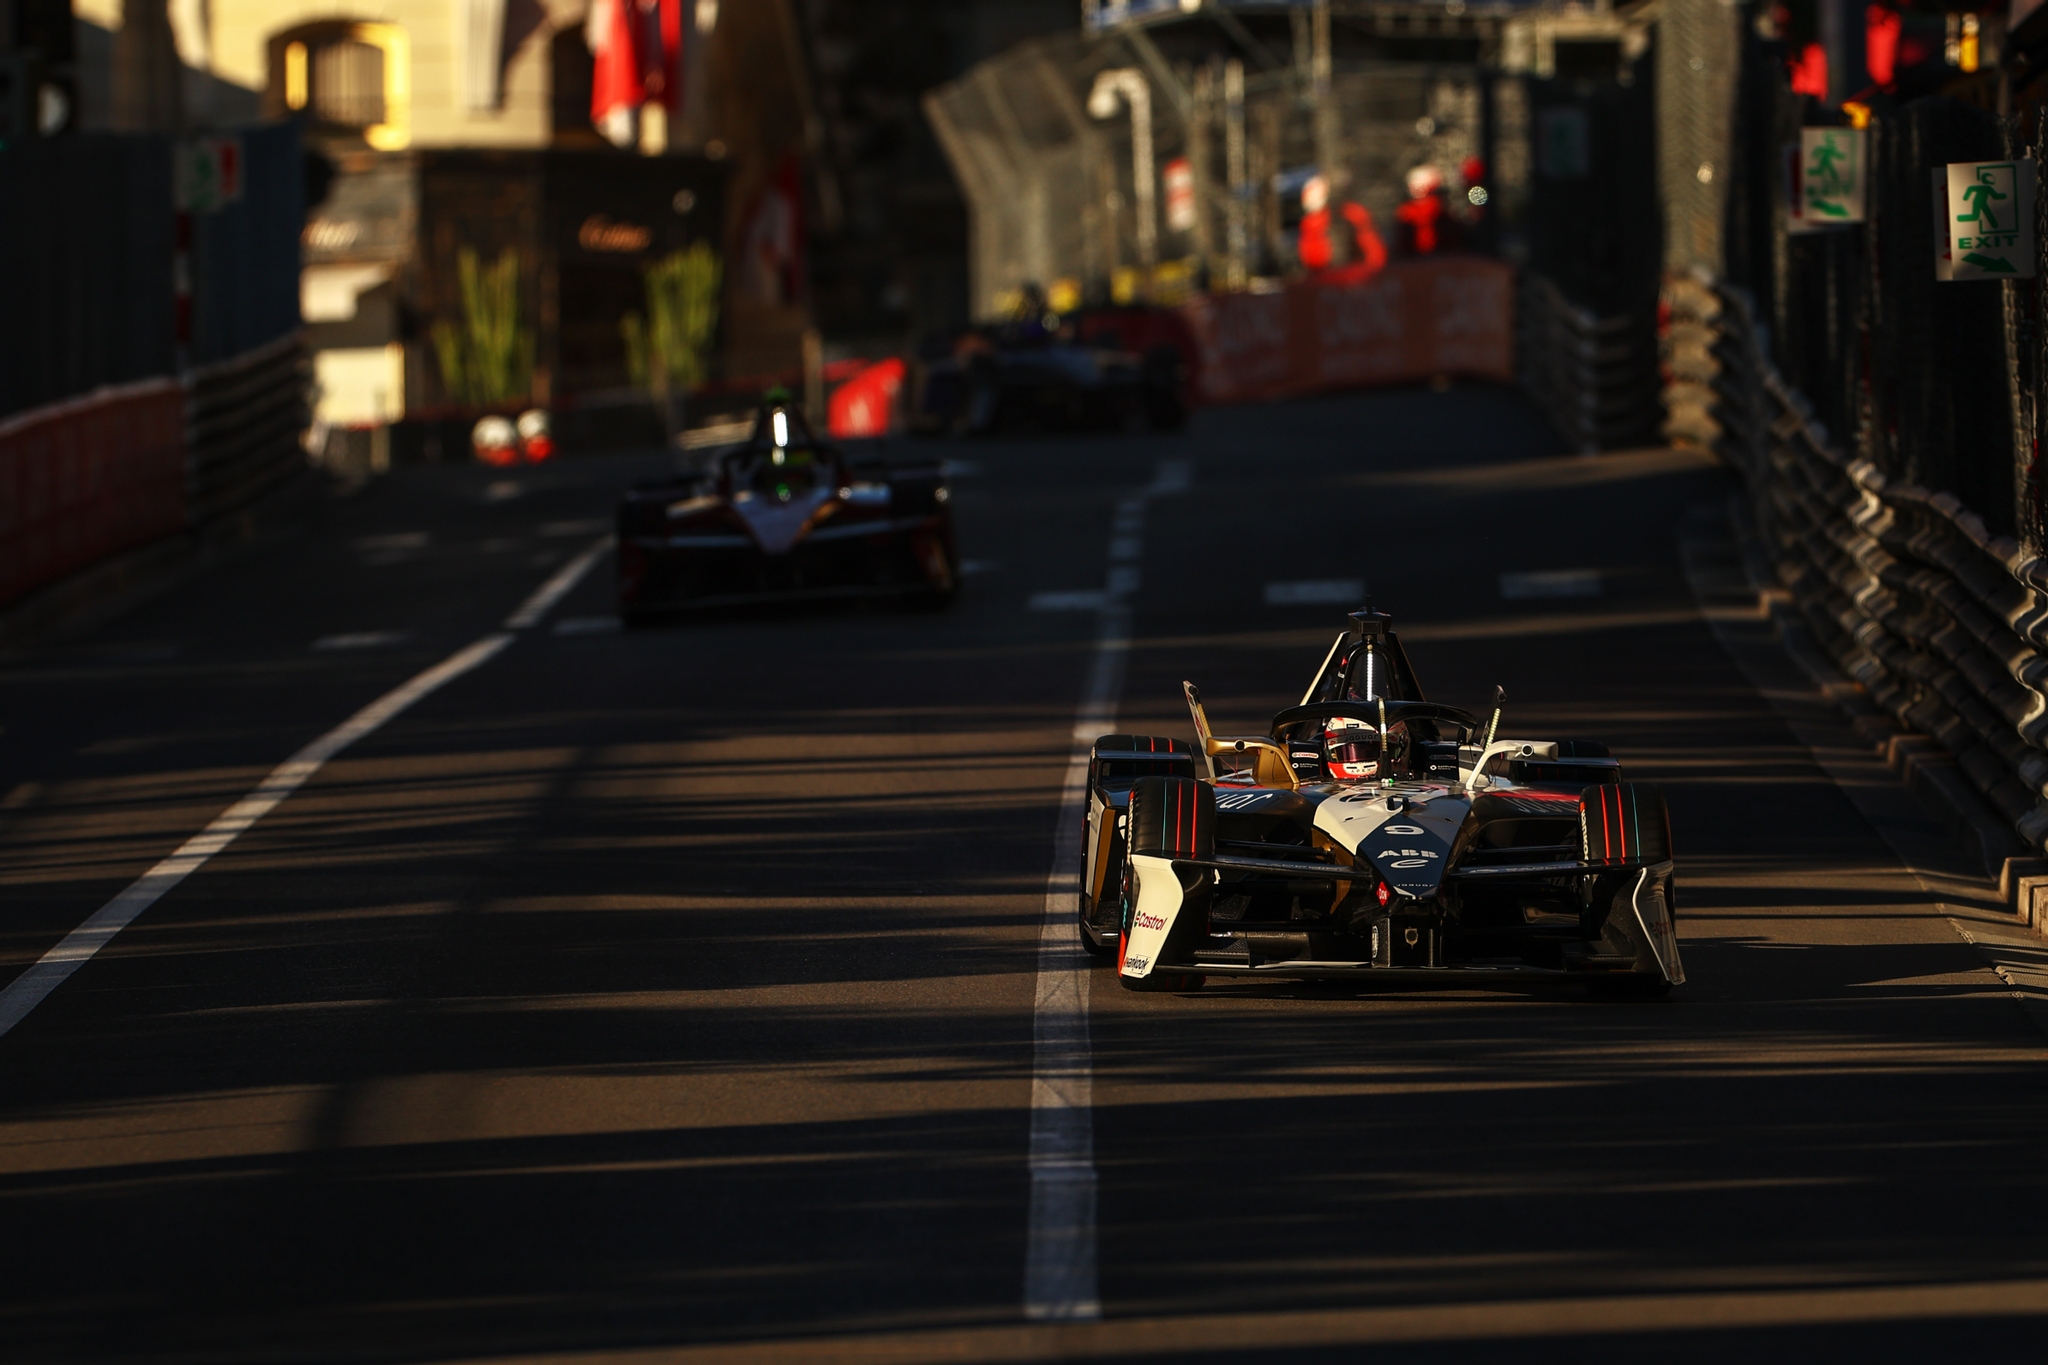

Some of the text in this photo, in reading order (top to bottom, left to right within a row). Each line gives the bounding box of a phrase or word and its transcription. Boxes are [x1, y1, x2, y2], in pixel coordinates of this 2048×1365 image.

[1958, 235, 2018, 249] EXIT
[1384, 825, 1425, 835] 9
[1377, 849, 1439, 859] ABB
[1138, 912, 1168, 931] Castrol
